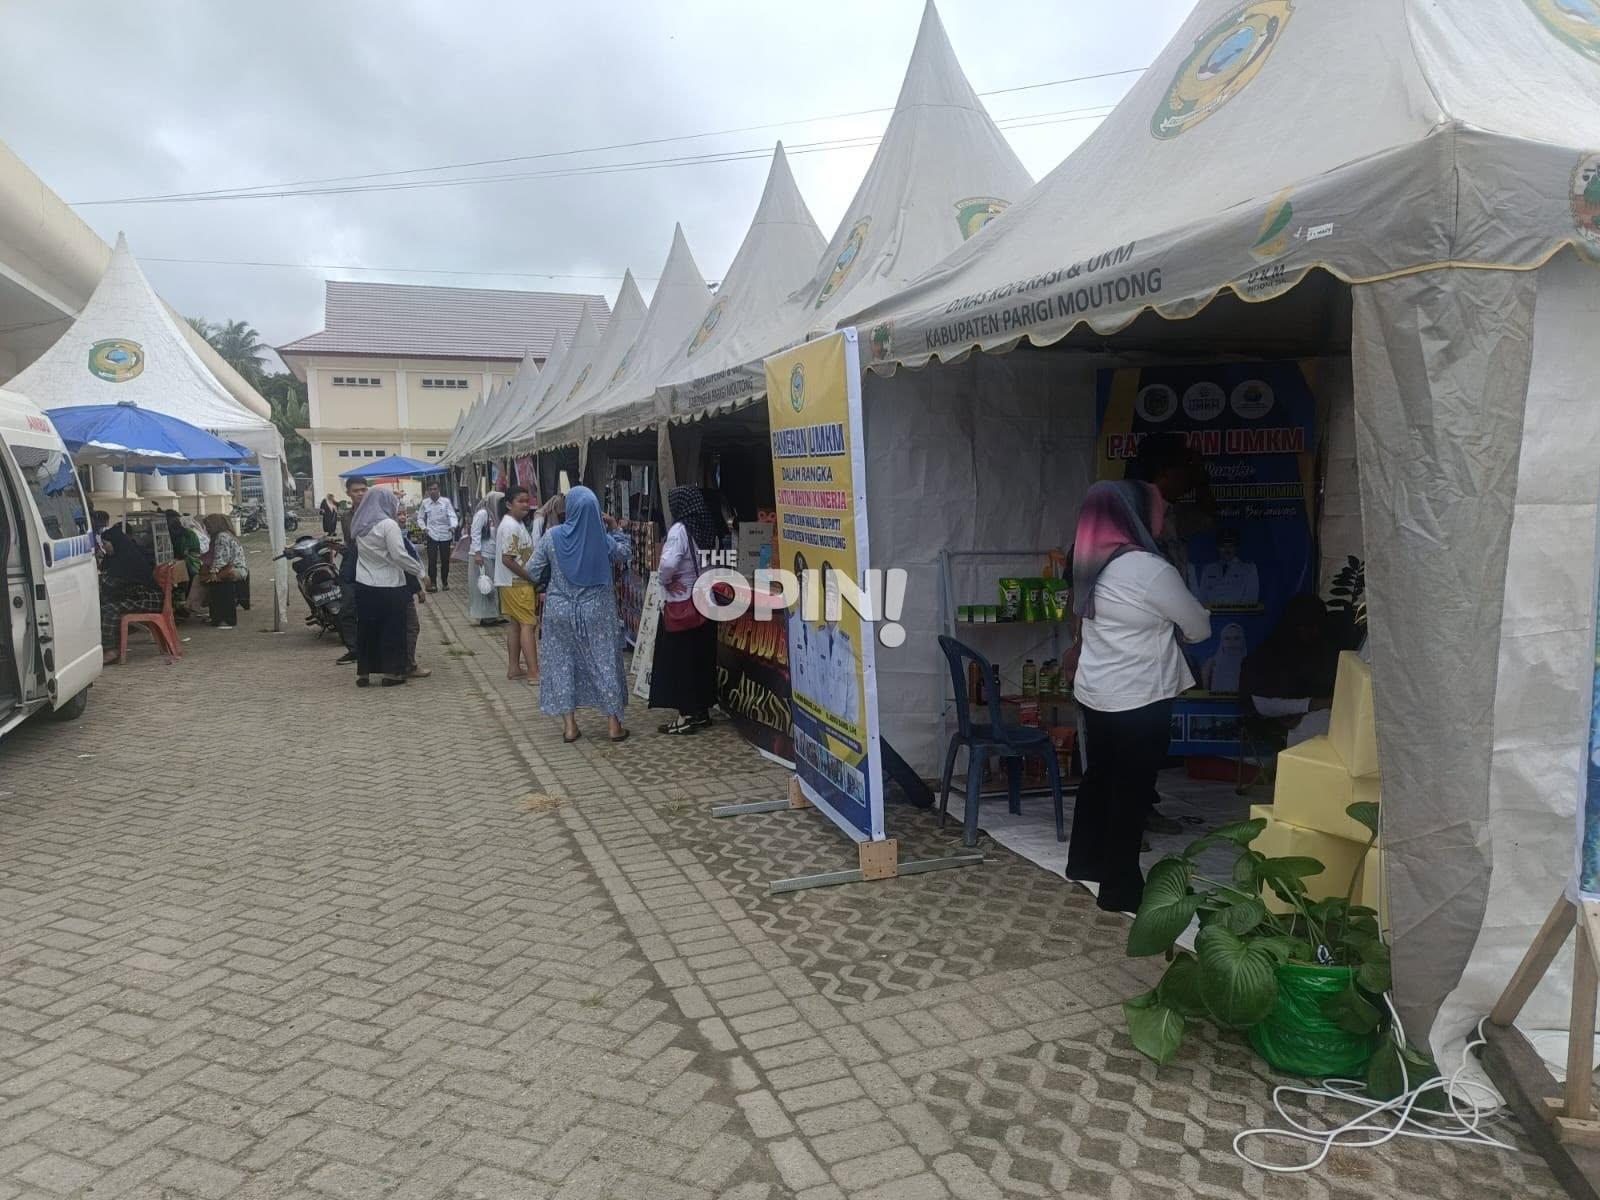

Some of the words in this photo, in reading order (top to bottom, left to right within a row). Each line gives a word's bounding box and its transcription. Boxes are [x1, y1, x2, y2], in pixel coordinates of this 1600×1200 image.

[1066, 262, 1081, 278] &
[1087, 240, 1136, 272] UKM
[924, 313, 1000, 350] KABUPATEN
[1003, 297, 1054, 331] PARIGI
[1057, 267, 1162, 316] MOUTONG
[772, 428, 808, 459] PAMERAN
[808, 424, 846, 457] UMKM
[1106, 430, 1221, 459] PAAN
[1225, 427, 1305, 455] UMKM
[781, 465, 801, 482] DALAM
[801, 465, 833, 482] RANGKA
[811, 490, 848, 511] KINERJA
